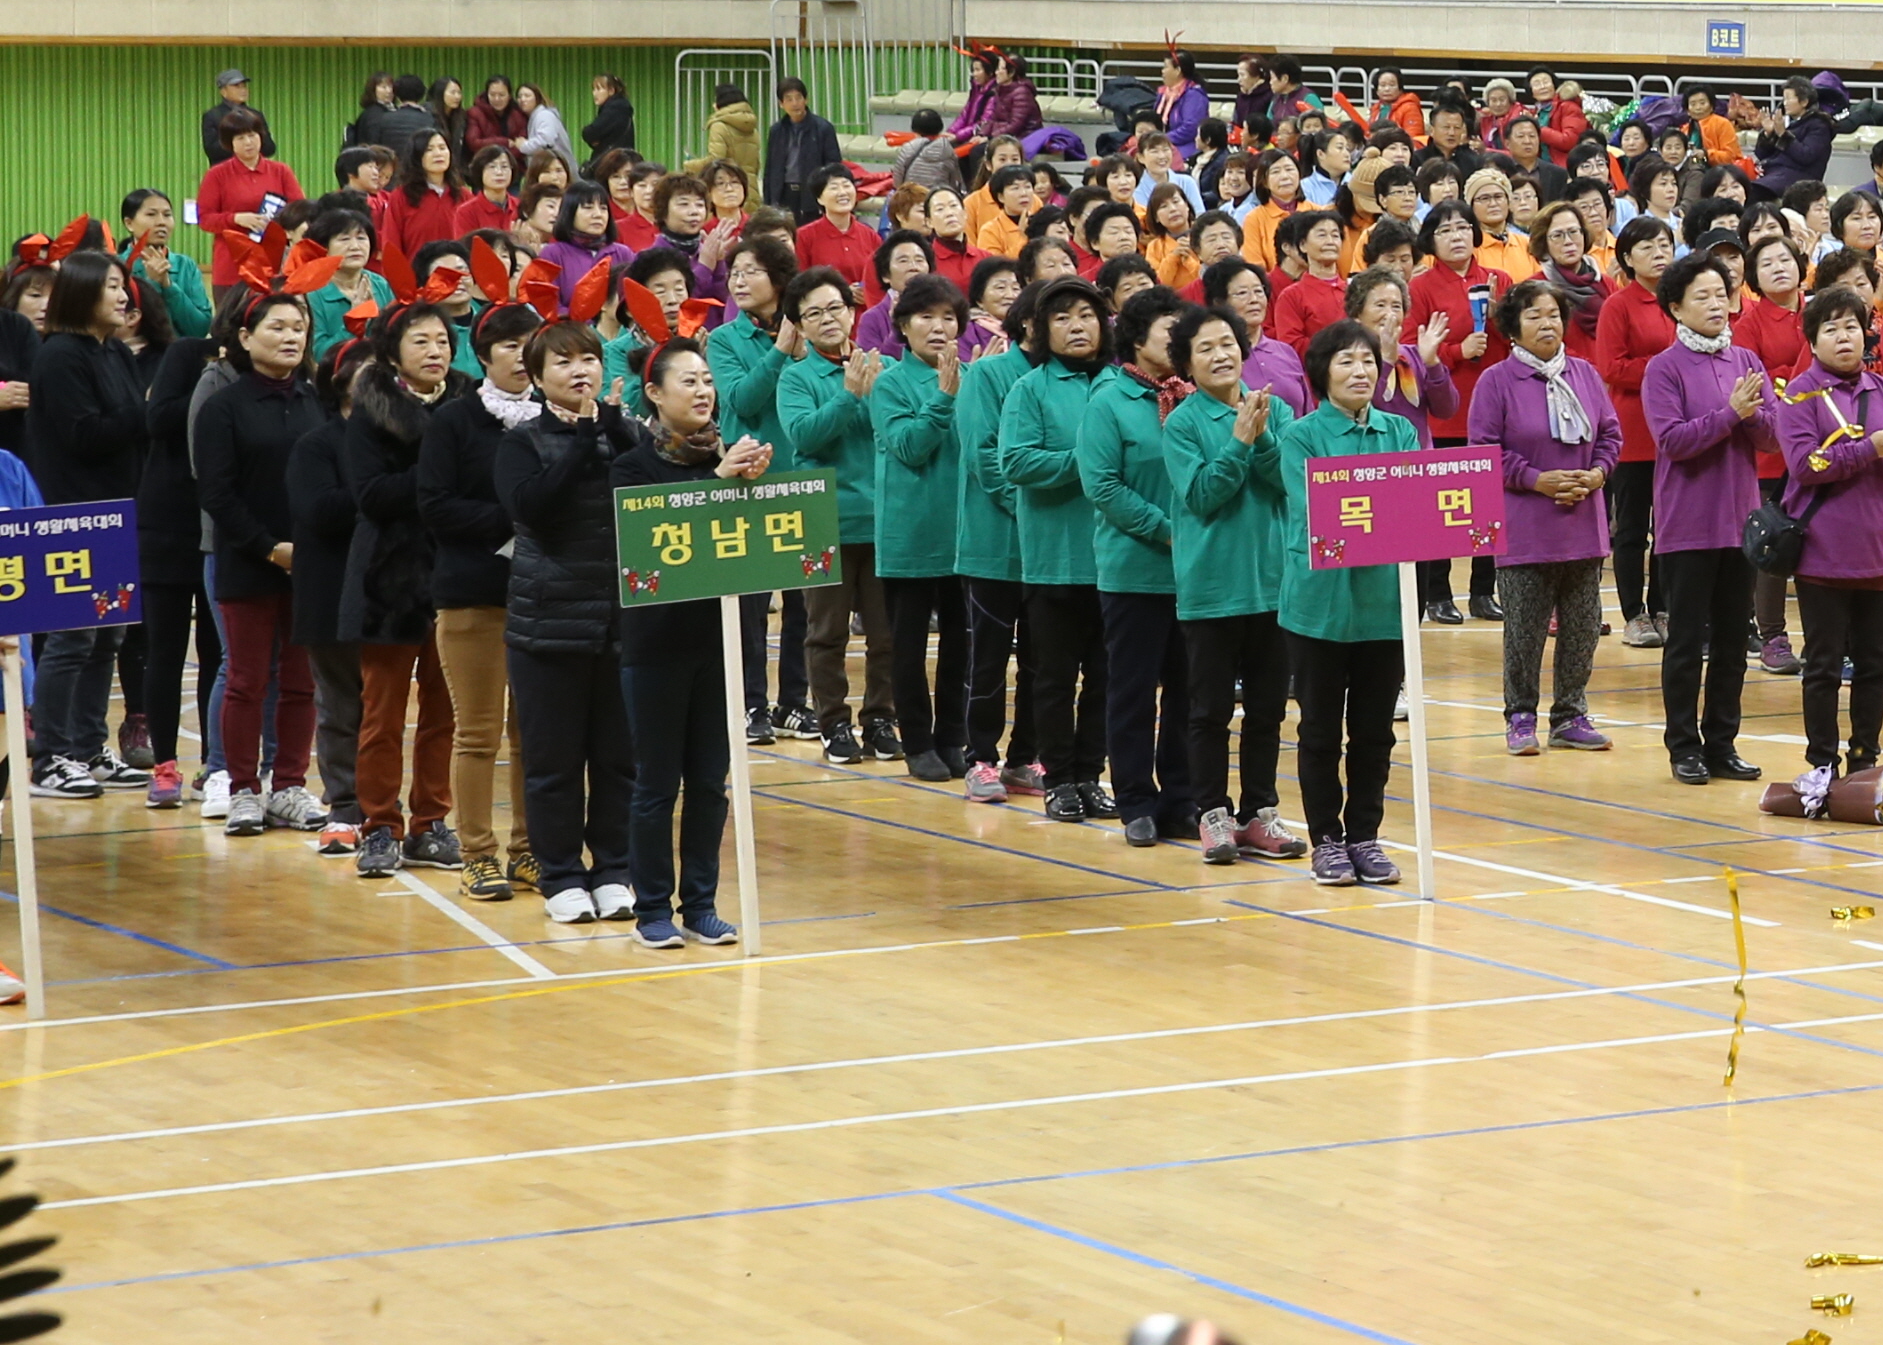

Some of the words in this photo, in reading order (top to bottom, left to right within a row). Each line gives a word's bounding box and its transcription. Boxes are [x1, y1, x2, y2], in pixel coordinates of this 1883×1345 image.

[1711, 28, 1740, 48] B코트
[1312, 470, 1350, 485] 제14회
[1353, 466, 1387, 482] 청양군
[1390, 463, 1424, 478] 어머니
[1426, 458, 1492, 476] 생활체육대회
[622, 496, 665, 512] 제14회
[668, 491, 707, 508] 청양군
[710, 487, 748, 503] 어머니
[751, 479, 826, 499] 생활체육대회
[0, 519, 30, 538] 머니
[34, 513, 123, 535] 생활체육대회
